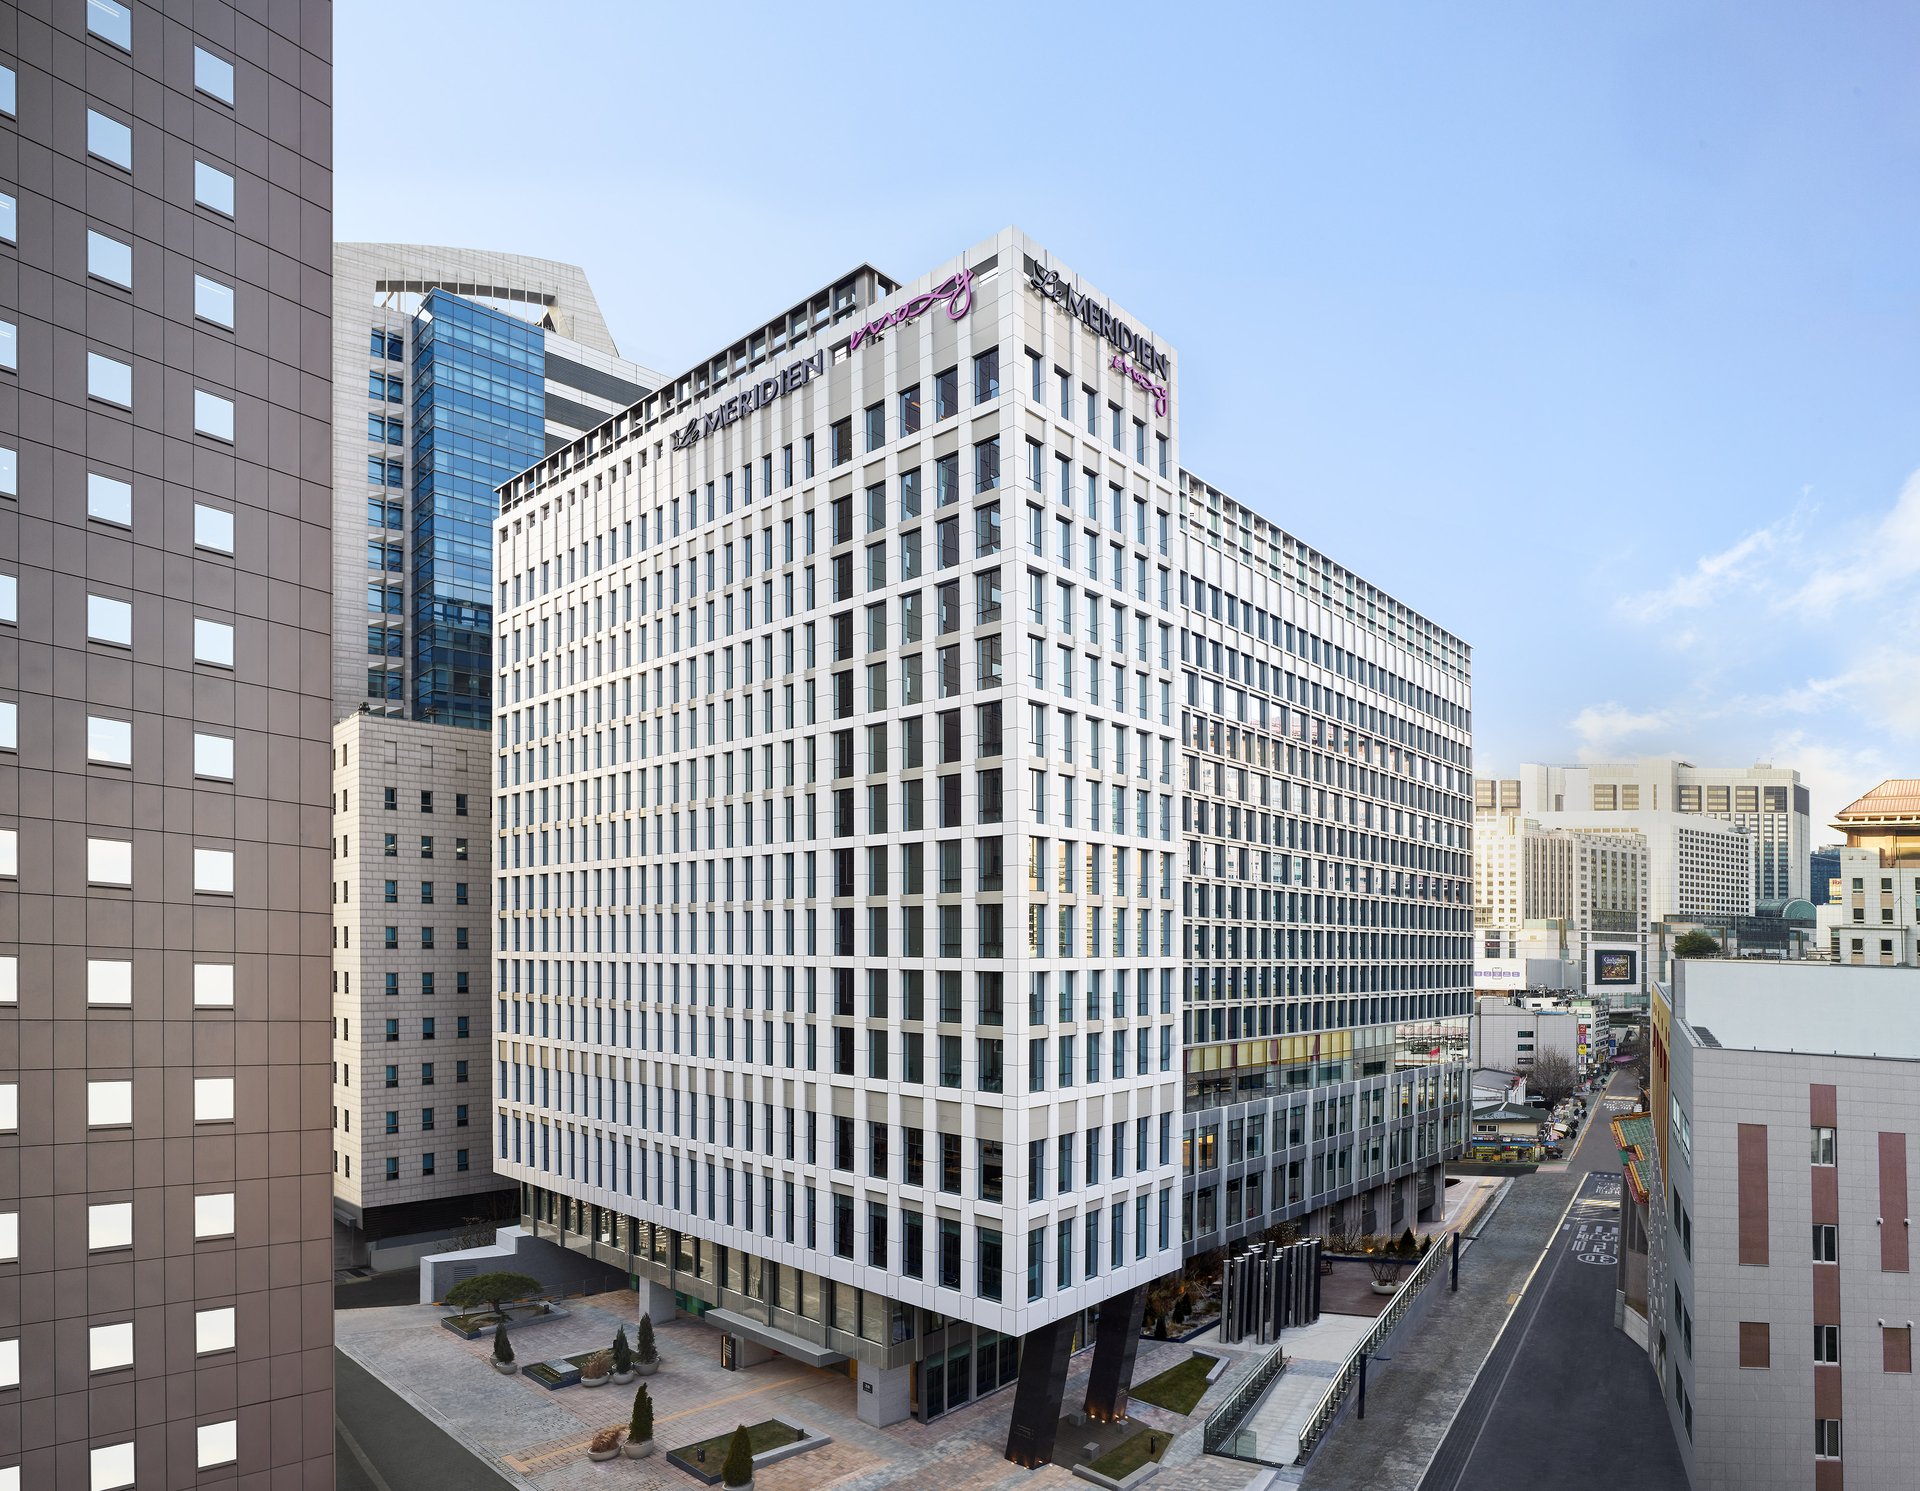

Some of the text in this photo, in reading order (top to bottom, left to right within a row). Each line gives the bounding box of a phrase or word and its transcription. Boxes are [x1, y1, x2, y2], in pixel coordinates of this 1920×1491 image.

[850, 268, 975, 351] moxy
[1031, 259, 1168, 382] Le MERIDIEN
[673, 348, 824, 452] Le MERIDIEN
